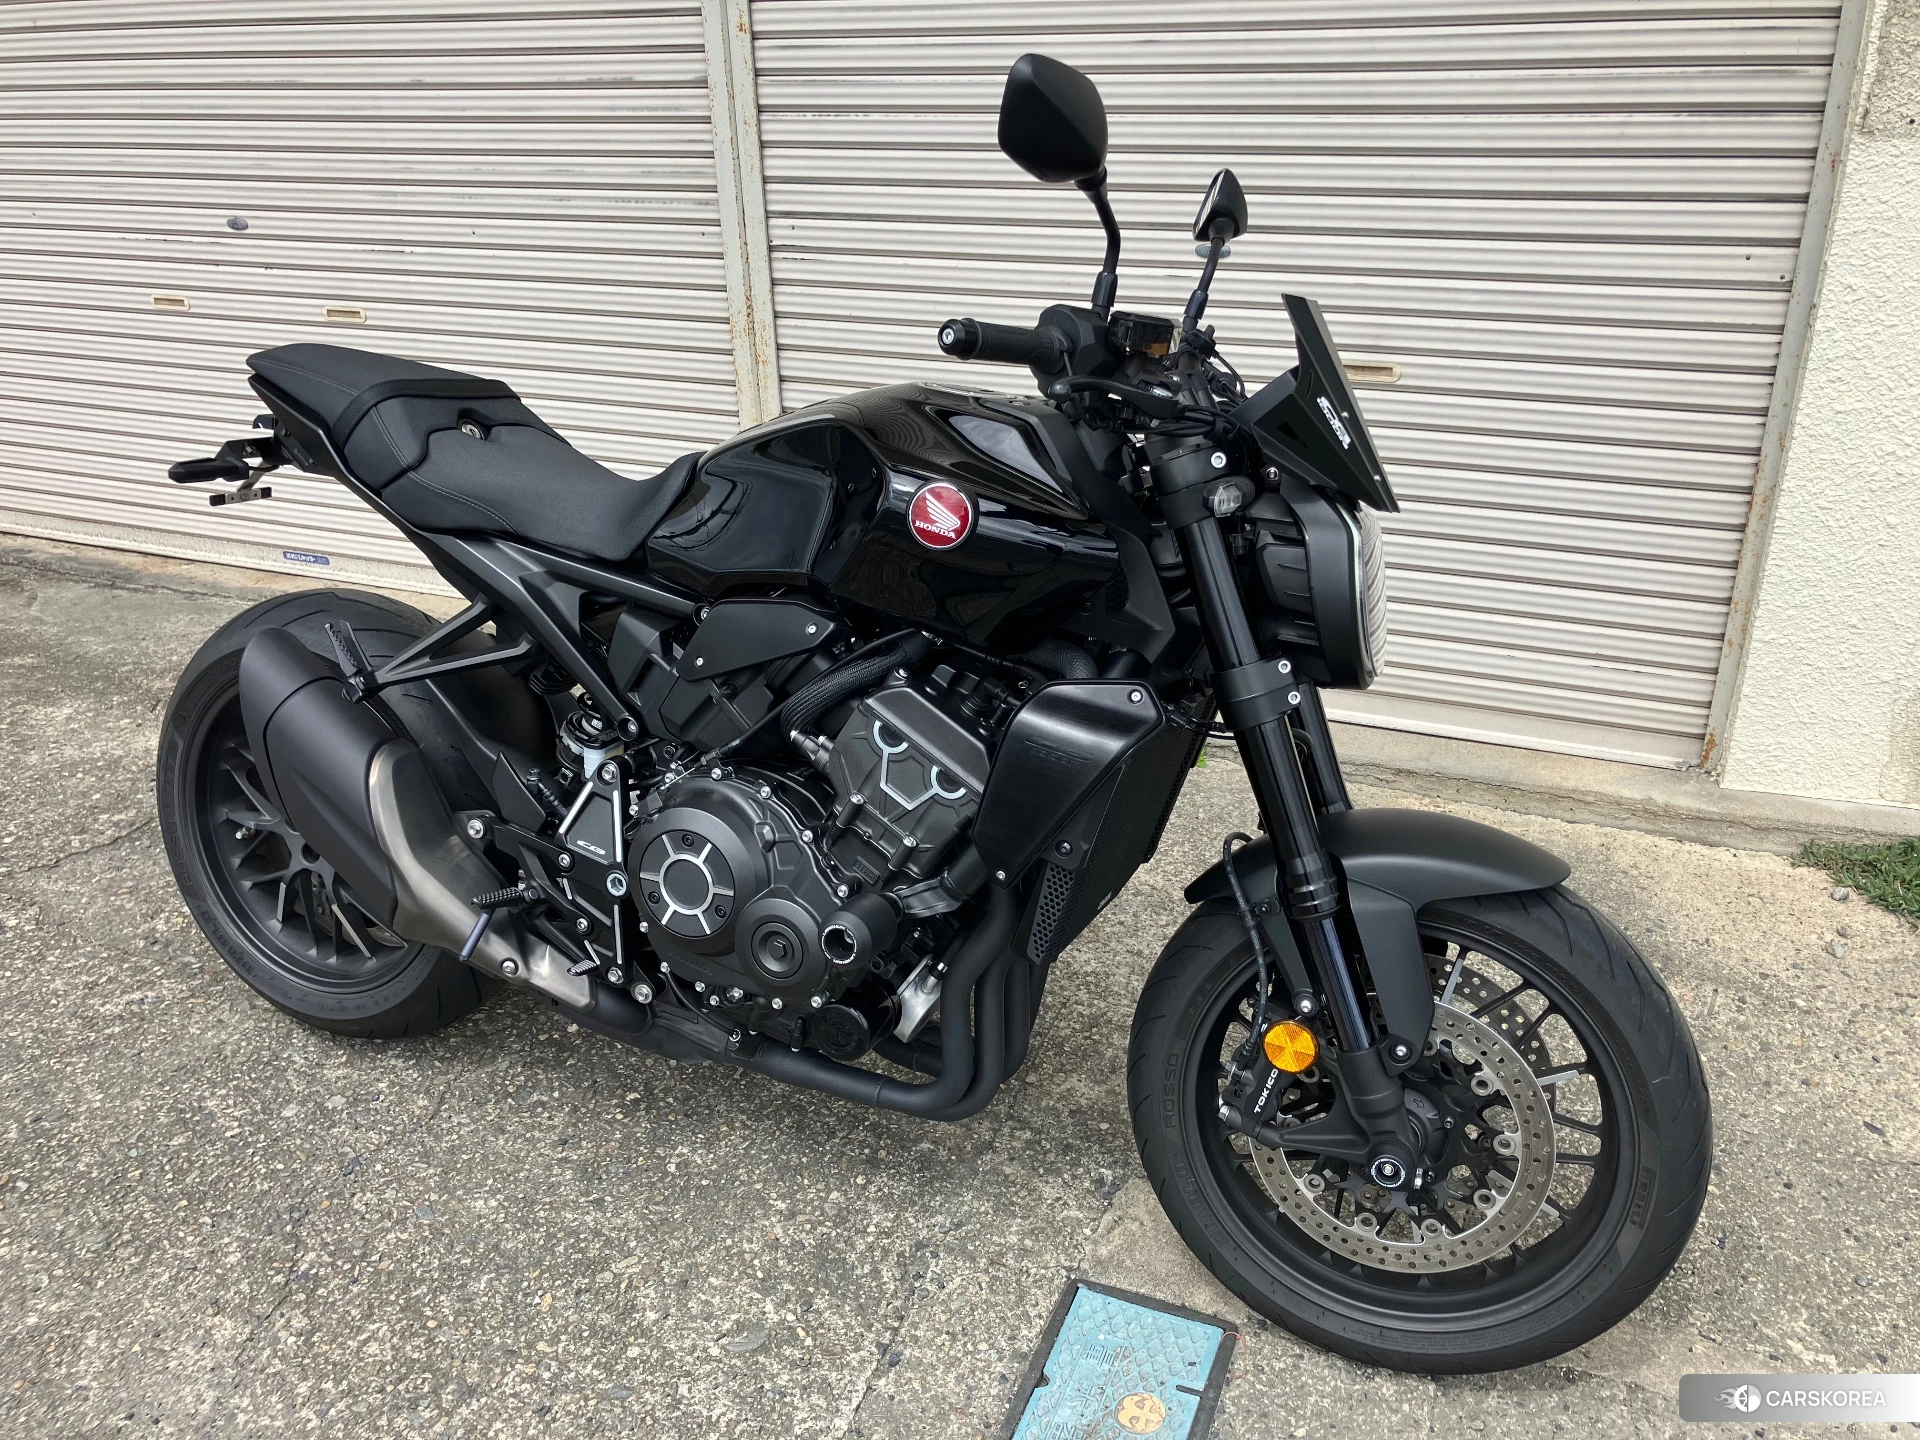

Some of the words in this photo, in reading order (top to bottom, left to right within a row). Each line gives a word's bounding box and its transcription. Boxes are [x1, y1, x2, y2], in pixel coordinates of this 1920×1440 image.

[914, 520, 957, 540] HONDA
[1163, 1052, 1179, 1129] ROSSO
[1253, 1068, 1279, 1114] TOKICO
